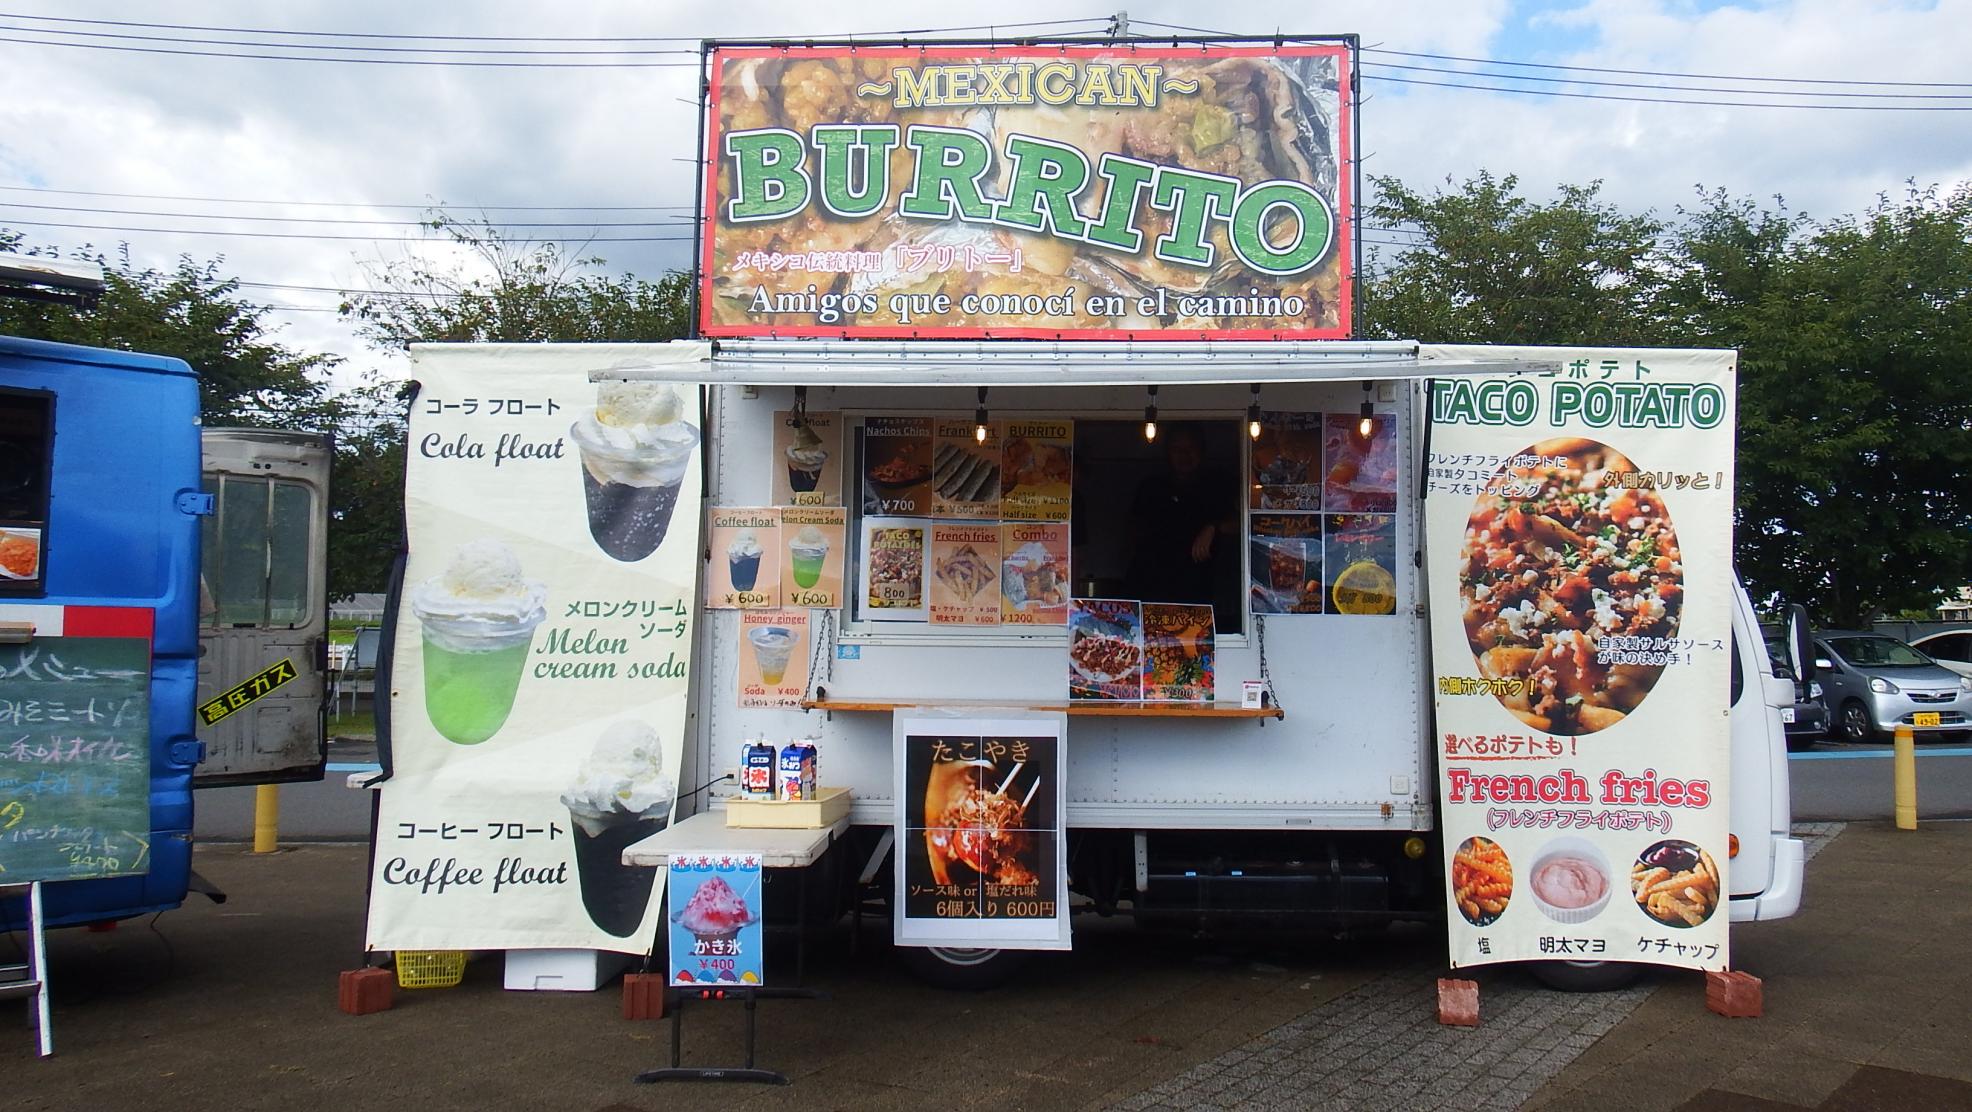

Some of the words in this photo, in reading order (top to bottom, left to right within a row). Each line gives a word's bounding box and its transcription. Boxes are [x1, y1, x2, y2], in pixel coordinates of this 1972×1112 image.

[725, 122, 1334, 278] BURRITO
[733, 250, 882, 274] メキシコ伝統料理
[750, 284, 877, 320] Amigos
[889, 291, 953, 323] que
[961, 284, 1075, 317] conocí
[1086, 293, 1128, 317] en
[1137, 284, 1168, 317] el
[1178, 285, 1305, 318] camino
[426, 398, 479, 416] コーラ
[488, 397, 561, 416] フロート
[1427, 379, 1539, 427] TACO
[1550, 381, 1726, 430] POTATO
[866, 426, 902, 436] Nachos
[1009, 426, 1066, 437] BURRITO
[420, 432, 486, 458] Cola
[494, 432, 566, 467] float
[881, 499, 915, 512] ¥700
[714, 516, 749, 527] Coffee
[751, 516, 775, 527] float
[799, 515, 824, 525] Cream
[825, 516, 844, 526] Soda
[1002, 511, 1019, 519] Half
[1046, 511, 1067, 520] ¥600
[936, 531, 971, 541] French
[973, 531, 996, 541] fries
[1013, 529, 1057, 540] Combo
[884, 586, 905, 599] 800
[565, 598, 688, 618] メロンクリーム
[744, 614, 773, 625] Honey
[777, 614, 806, 625] ginger
[640, 619, 687, 639] ソーダ
[535, 627, 630, 655] Melon
[1598, 636, 1724, 652] 自家製サルサソース
[534, 657, 618, 680] cream
[628, 651, 686, 680] soda
[204, 661, 295, 723] 高圧ガス
[745, 687, 765, 696] Soda
[778, 688, 800, 697] ¥400
[931, 740, 1031, 763] たこやき
[1447, 767, 1593, 806] French
[1600, 768, 1713, 810] fries
[397, 821, 479, 840] コーヒー
[488, 821, 565, 841] フロート
[383, 856, 484, 895] Coffee
[493, 856, 568, 895] float
[912, 884, 960, 897] ソース味
[963, 887, 978, 897] or
[985, 884, 1037, 897] 塩だれ味
[936, 900, 999, 918] 6個入り
[1006, 900, 1055, 918] 600円
[694, 938, 743, 956] かき氷
[1477, 937, 1491, 955] 塩
[1539, 936, 1607, 954] 明太マヨ
[1637, 936, 1720, 959] ケチャップ
[699, 958, 735, 970] ¥400
